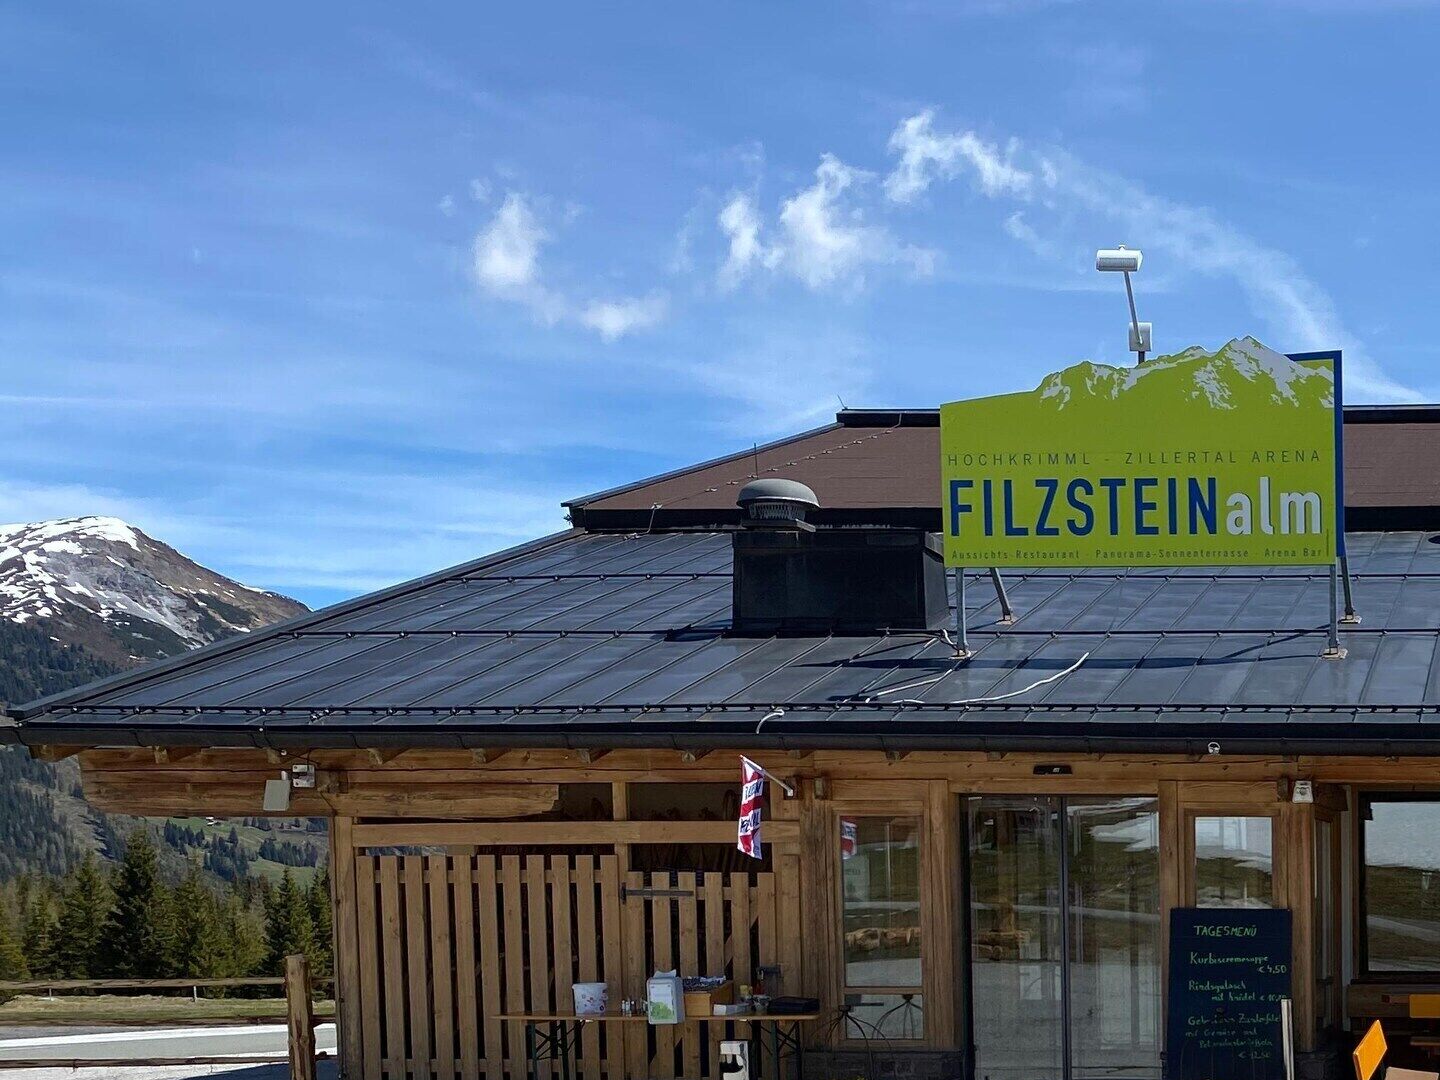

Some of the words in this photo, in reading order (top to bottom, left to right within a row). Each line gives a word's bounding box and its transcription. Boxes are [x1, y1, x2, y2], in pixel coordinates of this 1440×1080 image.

[947, 453, 1091, 466] HOCHKRIMML
[1125, 451, 1237, 465] ZILLERTAL
[1251, 449, 1321, 463] ARENA
[1193, 924, 1258, 938] TAGESMENÜ
